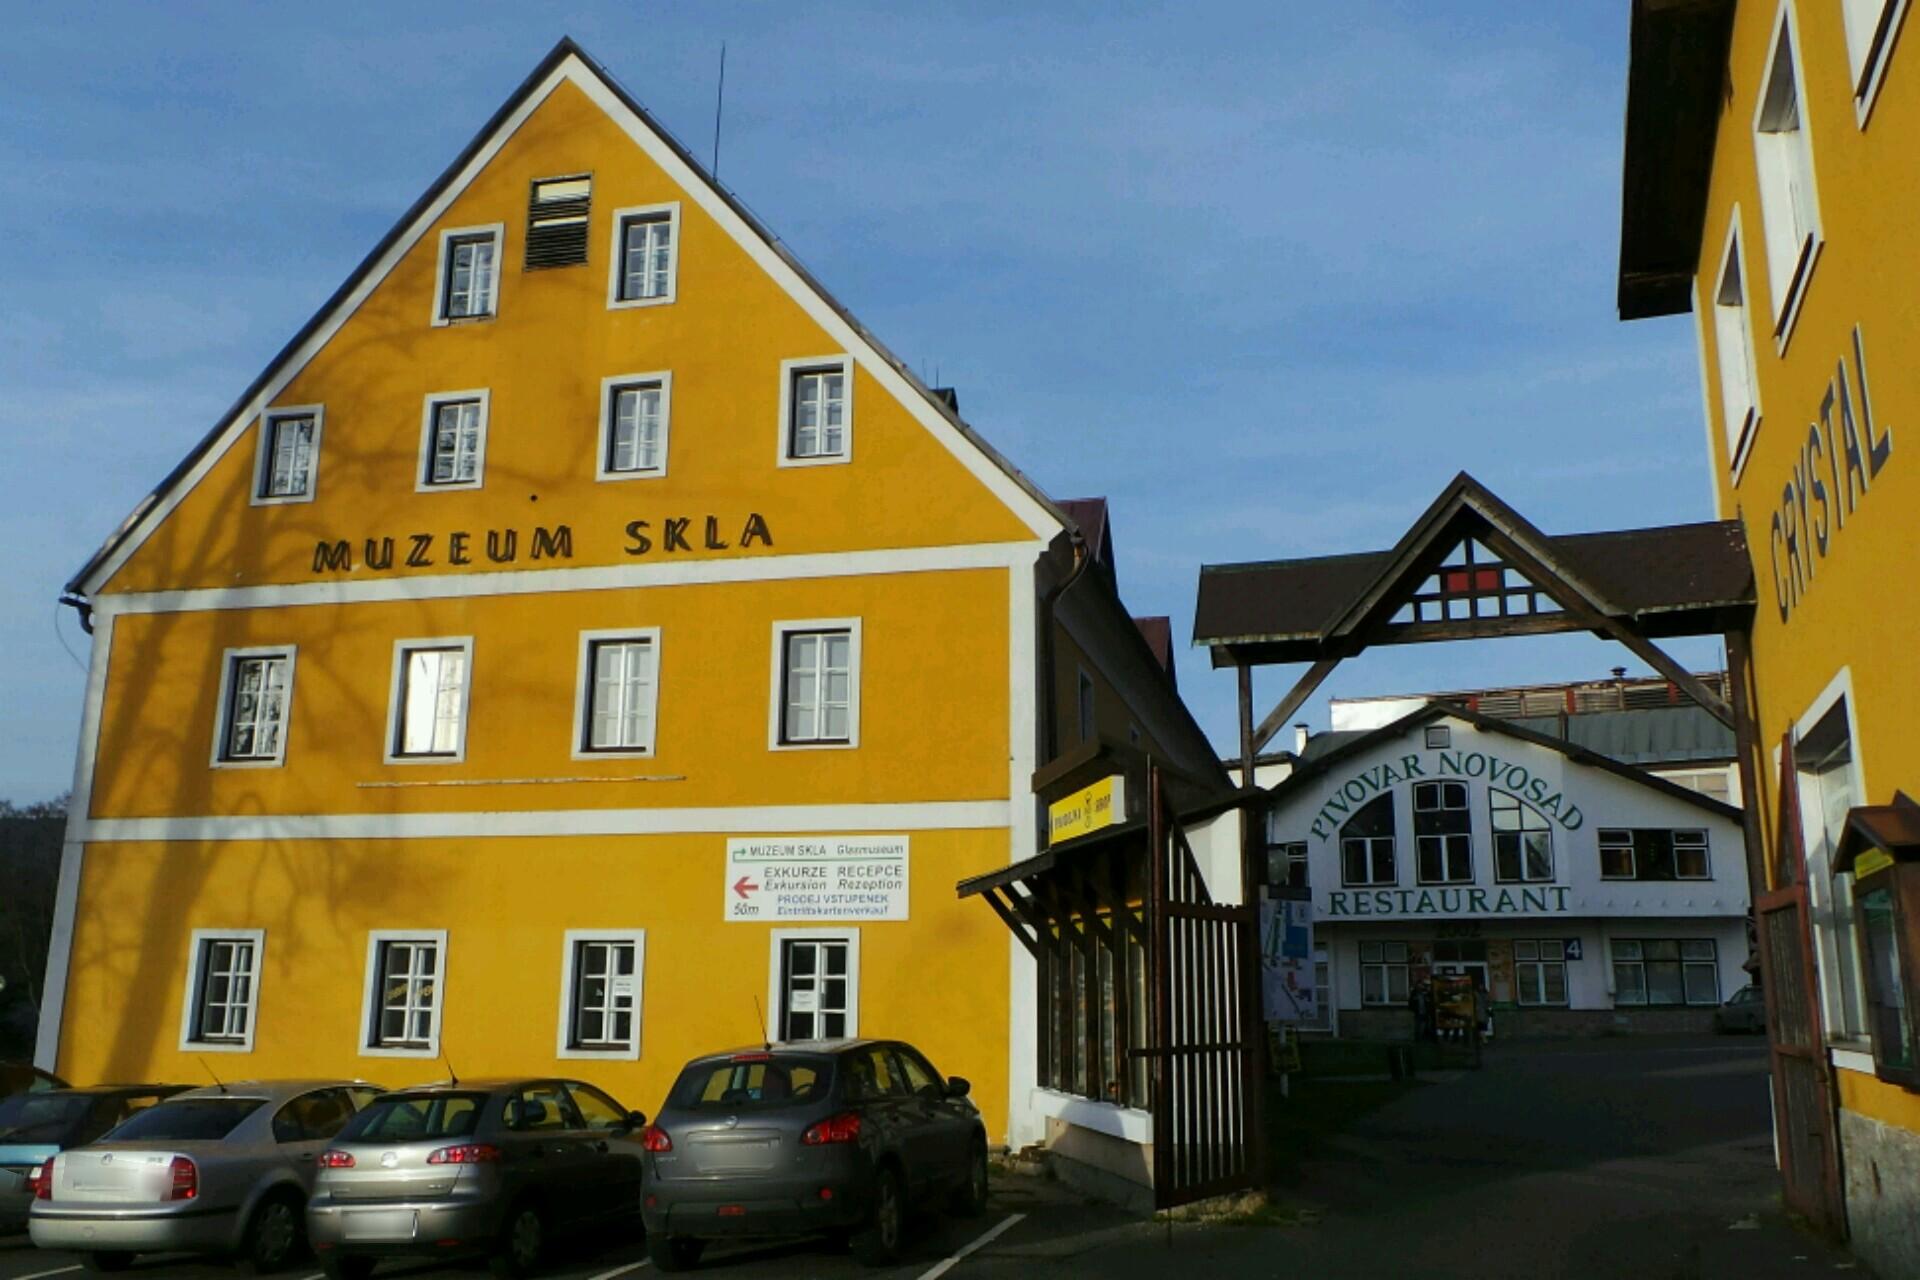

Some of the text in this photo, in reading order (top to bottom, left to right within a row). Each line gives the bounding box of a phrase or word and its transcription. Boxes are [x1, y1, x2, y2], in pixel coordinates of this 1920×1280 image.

[1771, 322, 1892, 624] CRYSTAL
[312, 513, 773, 573] MUZEUM SKLA
[1311, 751, 1583, 842] PIVOVAR NOVOSAD
[750, 845, 795, 856] MUZEUM
[799, 845, 826, 856] SKLA
[764, 865, 903, 878] EXKURZE RECEPCE
[764, 878, 902, 891] Exkursion Rezeption
[777, 894, 889, 904] PRODEJ VSTUPENEK
[1328, 886, 1572, 916] RESTAURANT
[1566, 939, 1581, 958] 4
